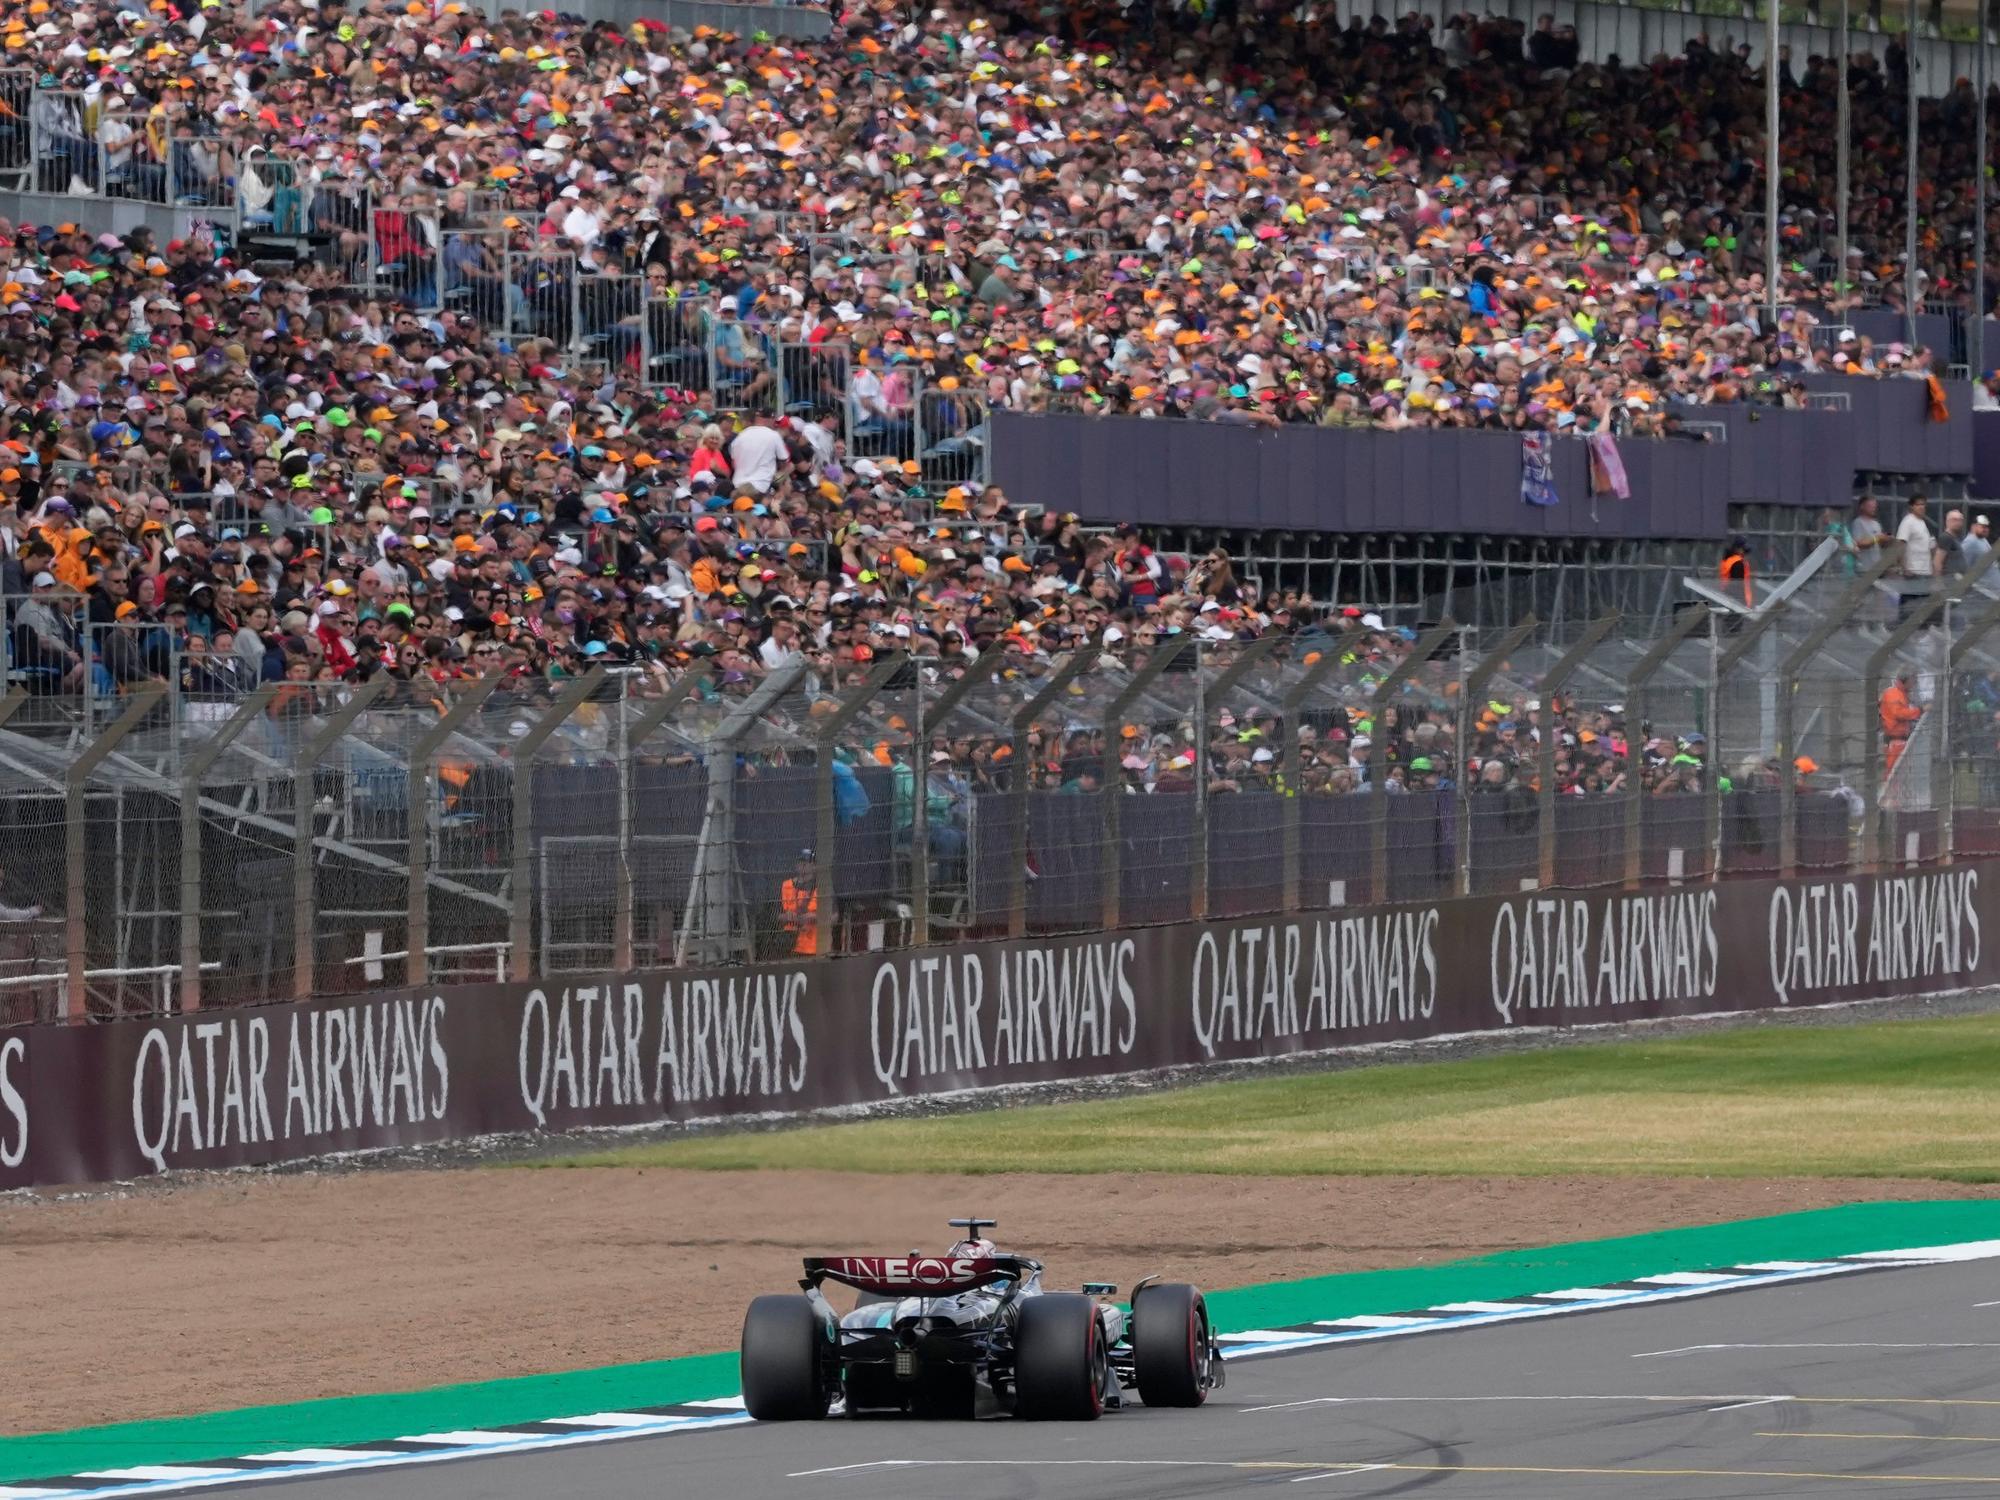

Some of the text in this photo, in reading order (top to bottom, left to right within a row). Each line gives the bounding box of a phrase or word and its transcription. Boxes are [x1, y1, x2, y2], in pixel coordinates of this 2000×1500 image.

[1192, 908, 1439, 1058] QATAR AIRWAYS
[1491, 888, 1718, 1025] QATAR AIRWAYS
[1769, 868, 1981, 1004] QATAR AIRWAYS
[132, 1016, 274, 1174] QATAR
[284, 995, 449, 1139] AIRWAYS
[519, 972, 808, 1128] QATAR AIRWAYS
[870, 938, 1137, 1095] QATAR AIRWAYS
[844, 1259, 976, 1284] INEOS
